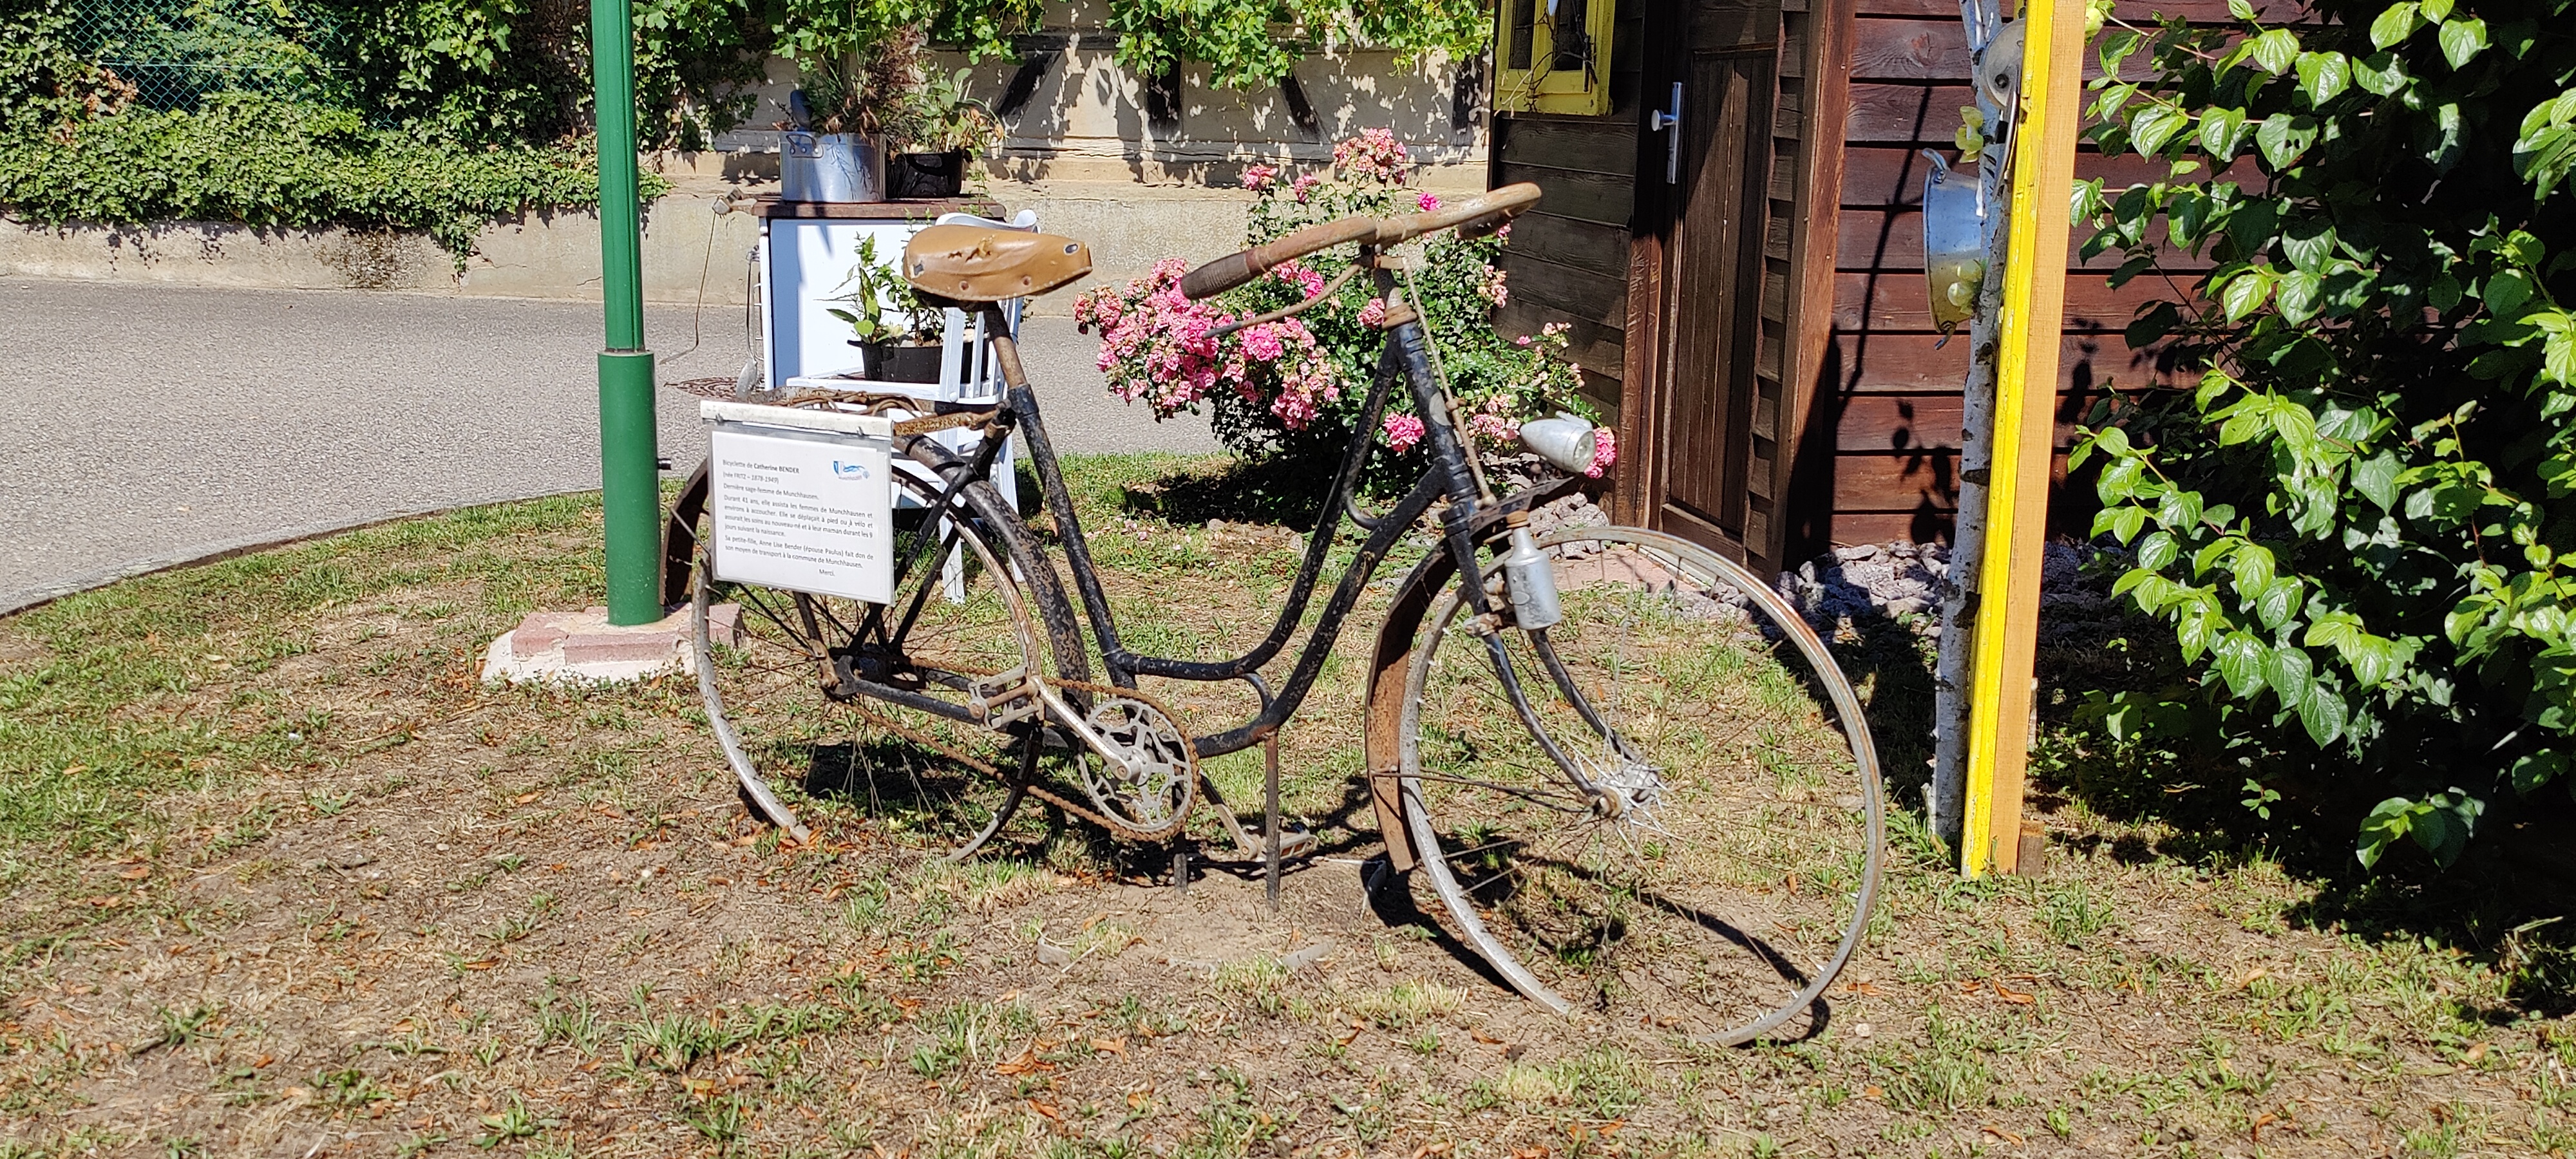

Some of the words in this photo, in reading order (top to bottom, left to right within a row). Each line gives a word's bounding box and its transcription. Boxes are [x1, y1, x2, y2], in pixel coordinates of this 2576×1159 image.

[754, 463, 778, 471] Catherine
[779, 466, 800, 474] BENDER
[799, 504, 819, 512] femmes
[829, 507, 866, 517] Munchhausen
[798, 514, 820, 522] déplaçait
[759, 550, 782, 558] transport
